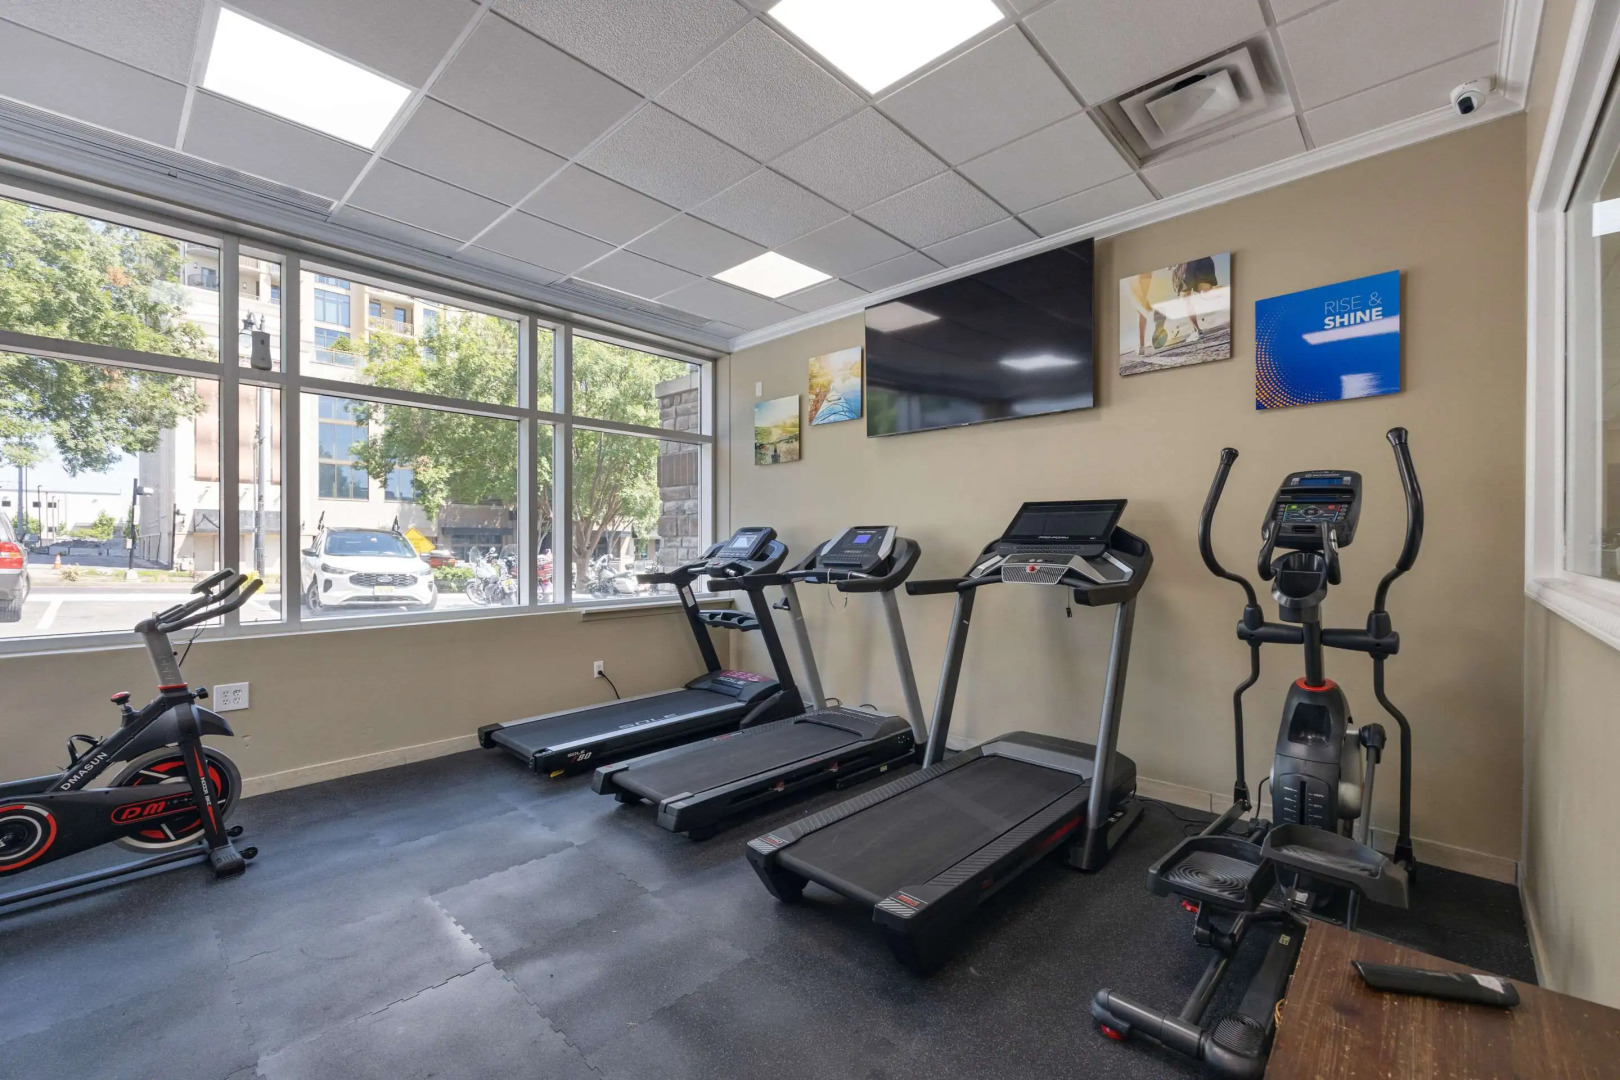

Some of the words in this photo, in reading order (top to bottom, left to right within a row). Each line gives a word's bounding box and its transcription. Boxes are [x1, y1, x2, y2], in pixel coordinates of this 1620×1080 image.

[1324, 295, 1362, 315] RISE
[1368, 291, 1382, 306] &
[1323, 306, 1383, 329] SHINE
[60, 751, 108, 791] DMASUN
